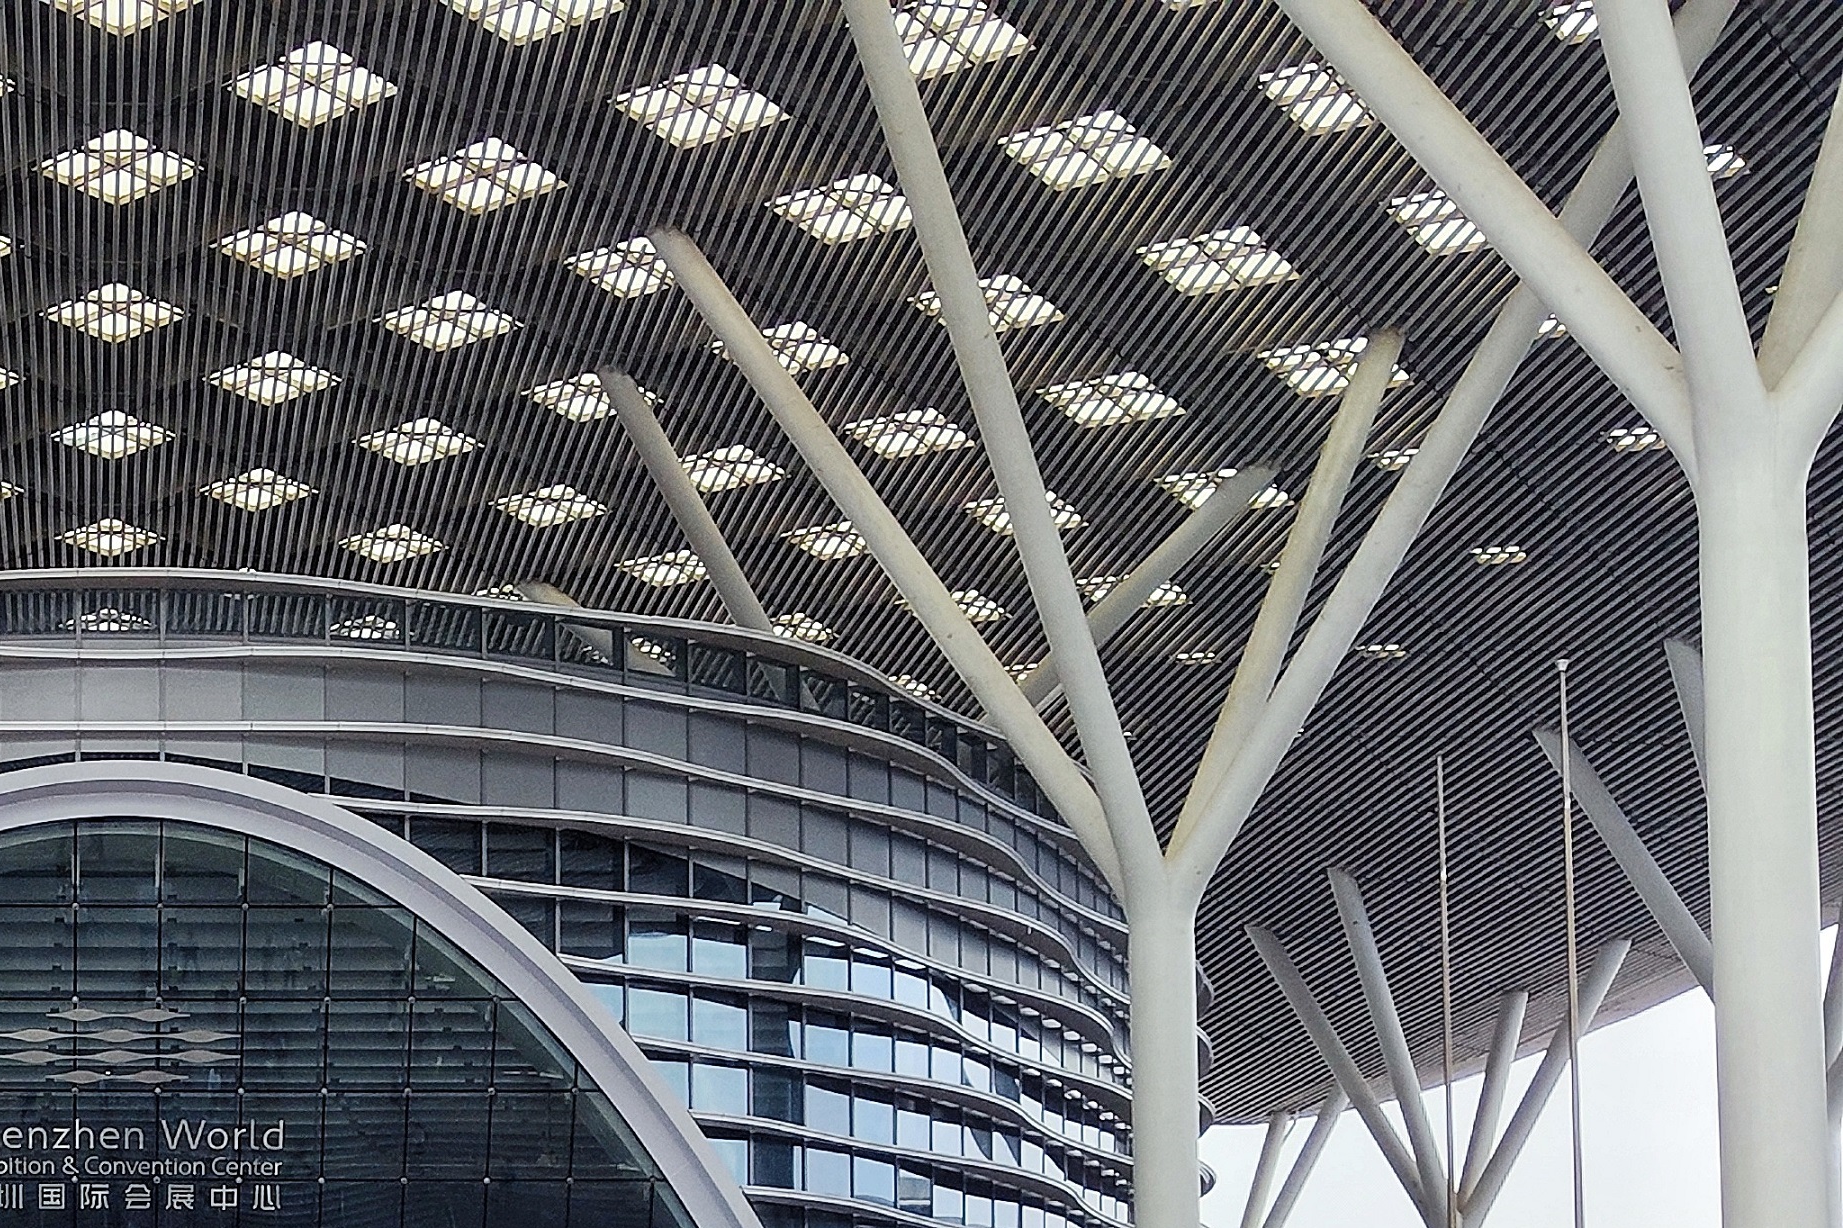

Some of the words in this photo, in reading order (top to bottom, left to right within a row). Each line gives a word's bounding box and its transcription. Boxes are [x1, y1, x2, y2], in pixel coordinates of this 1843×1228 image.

[161, 1118, 284, 1150] World
[62, 1156, 79, 1175] &
[84, 1156, 206, 1176] Convention
[211, 1157, 283, 1177] Center
